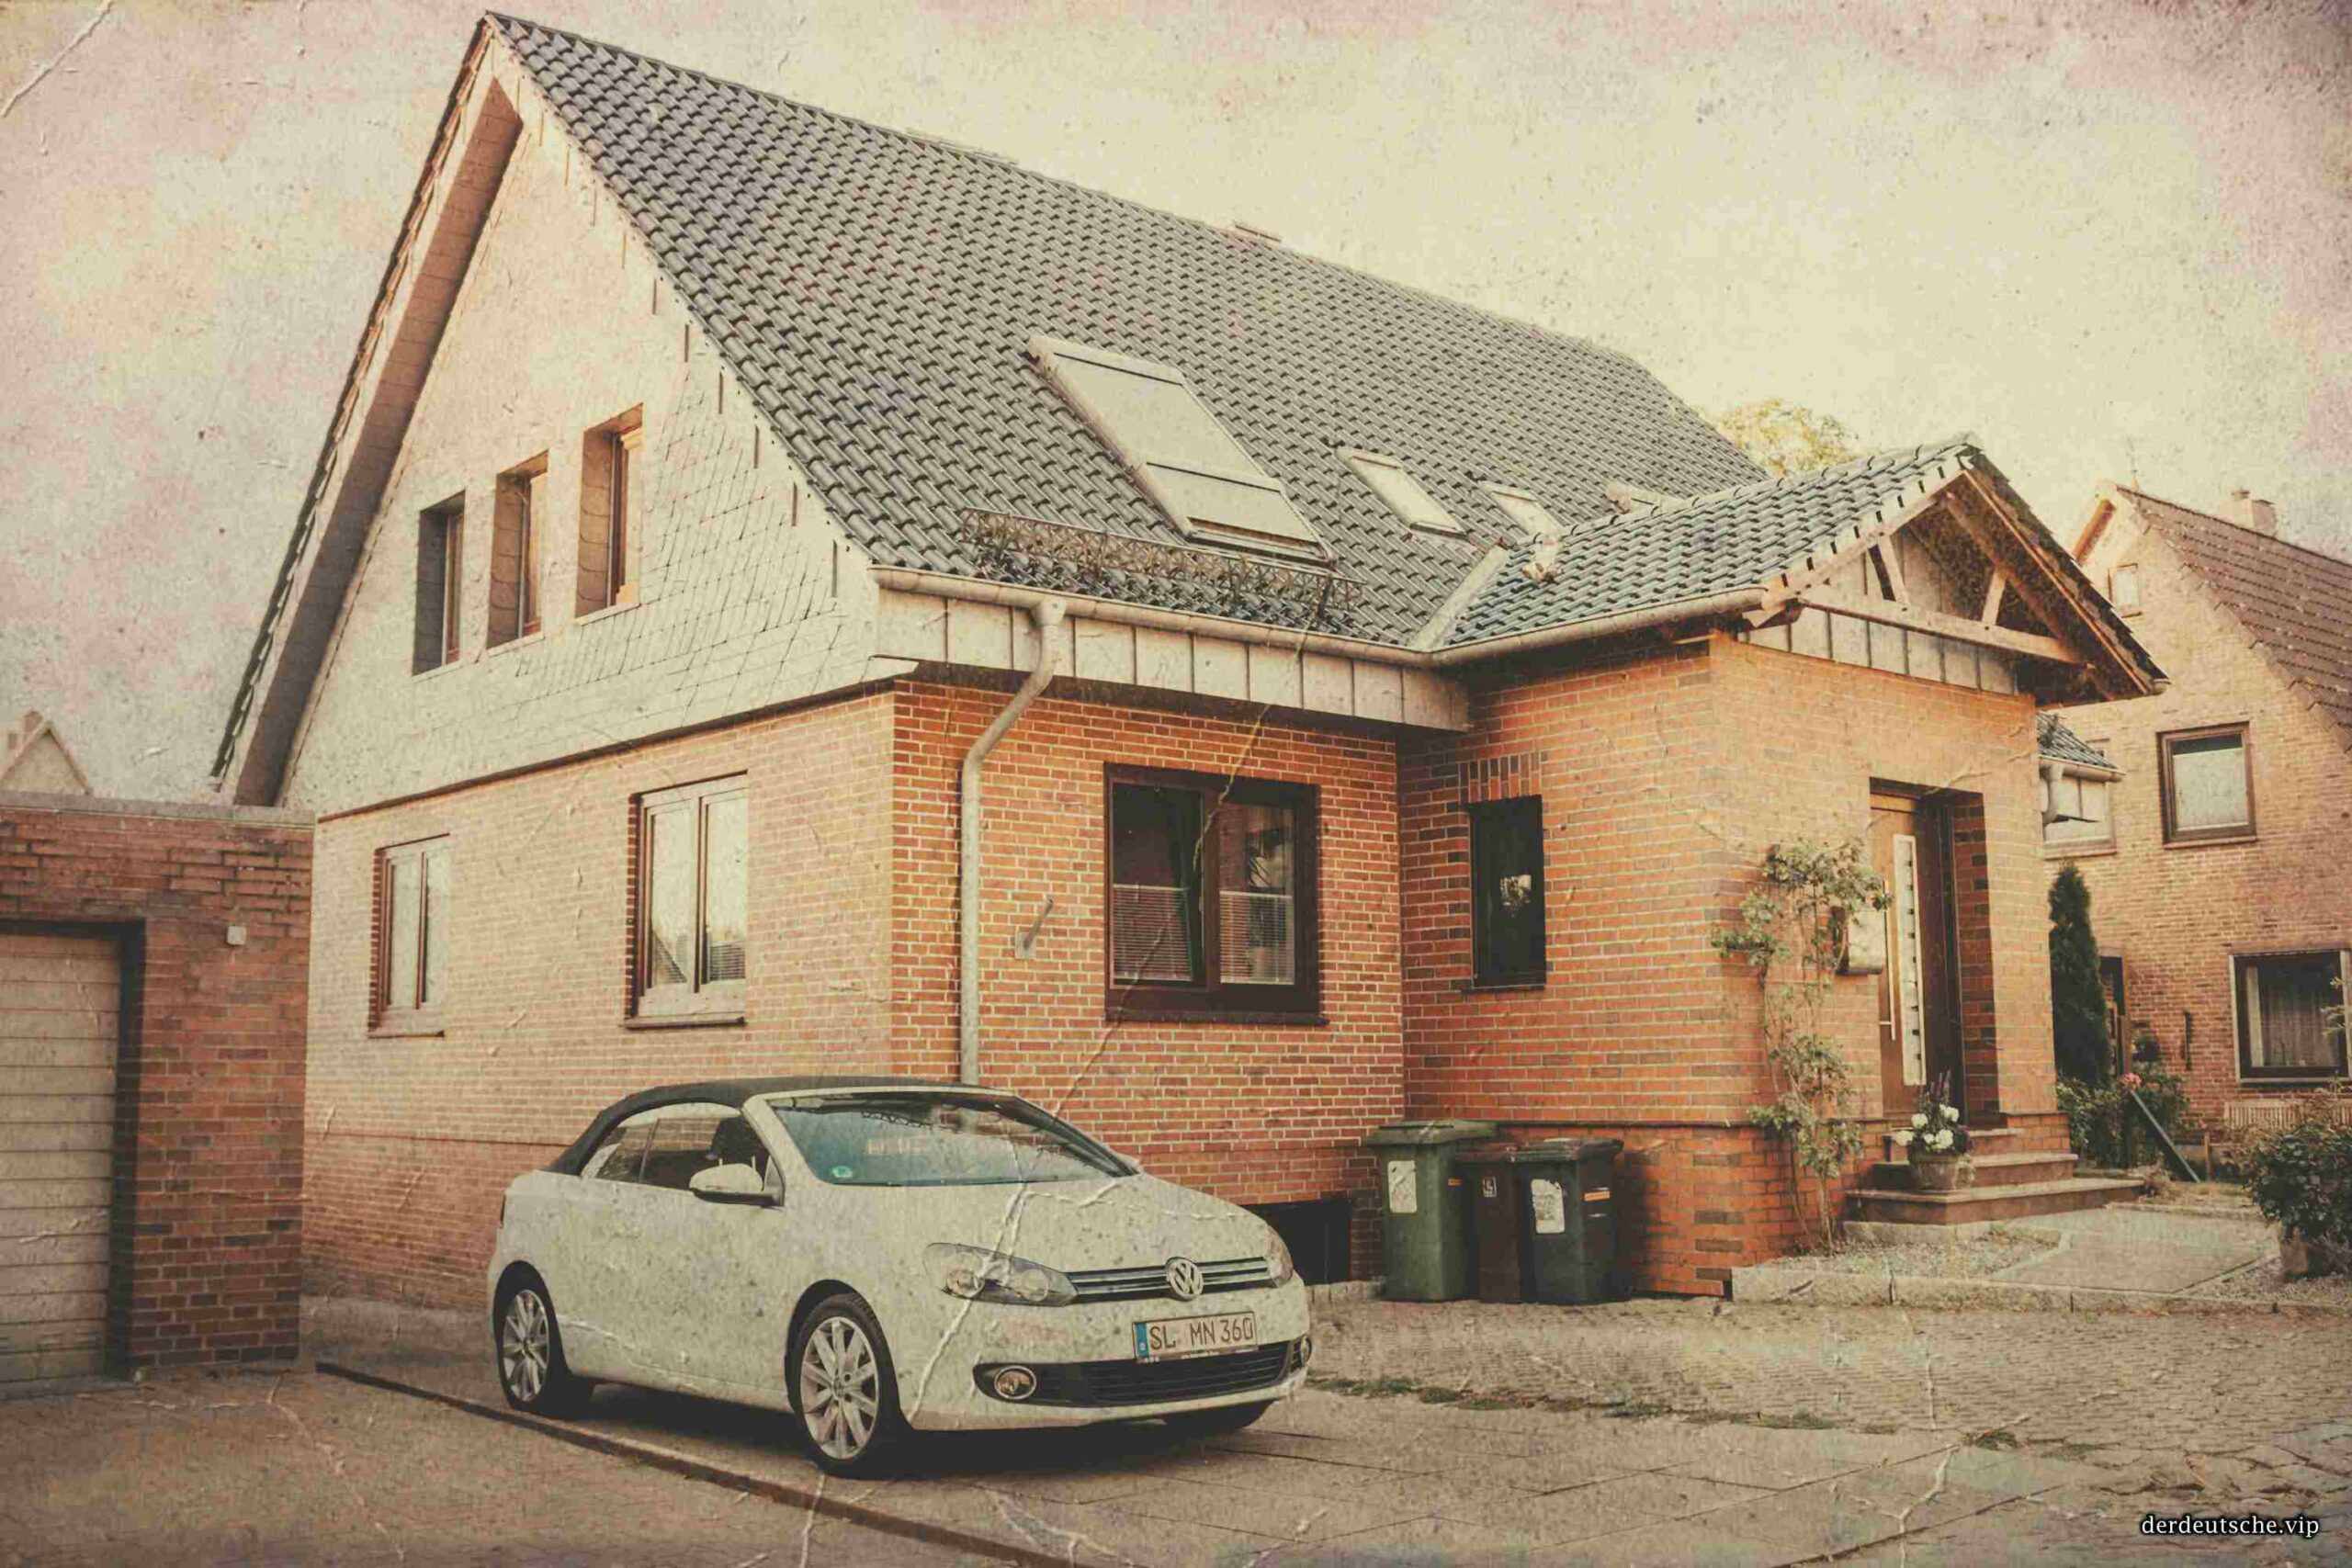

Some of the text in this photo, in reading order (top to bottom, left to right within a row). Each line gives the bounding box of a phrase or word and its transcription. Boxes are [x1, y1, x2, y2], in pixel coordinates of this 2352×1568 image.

[1149, 1316, 1254, 1350] SL MN 360
